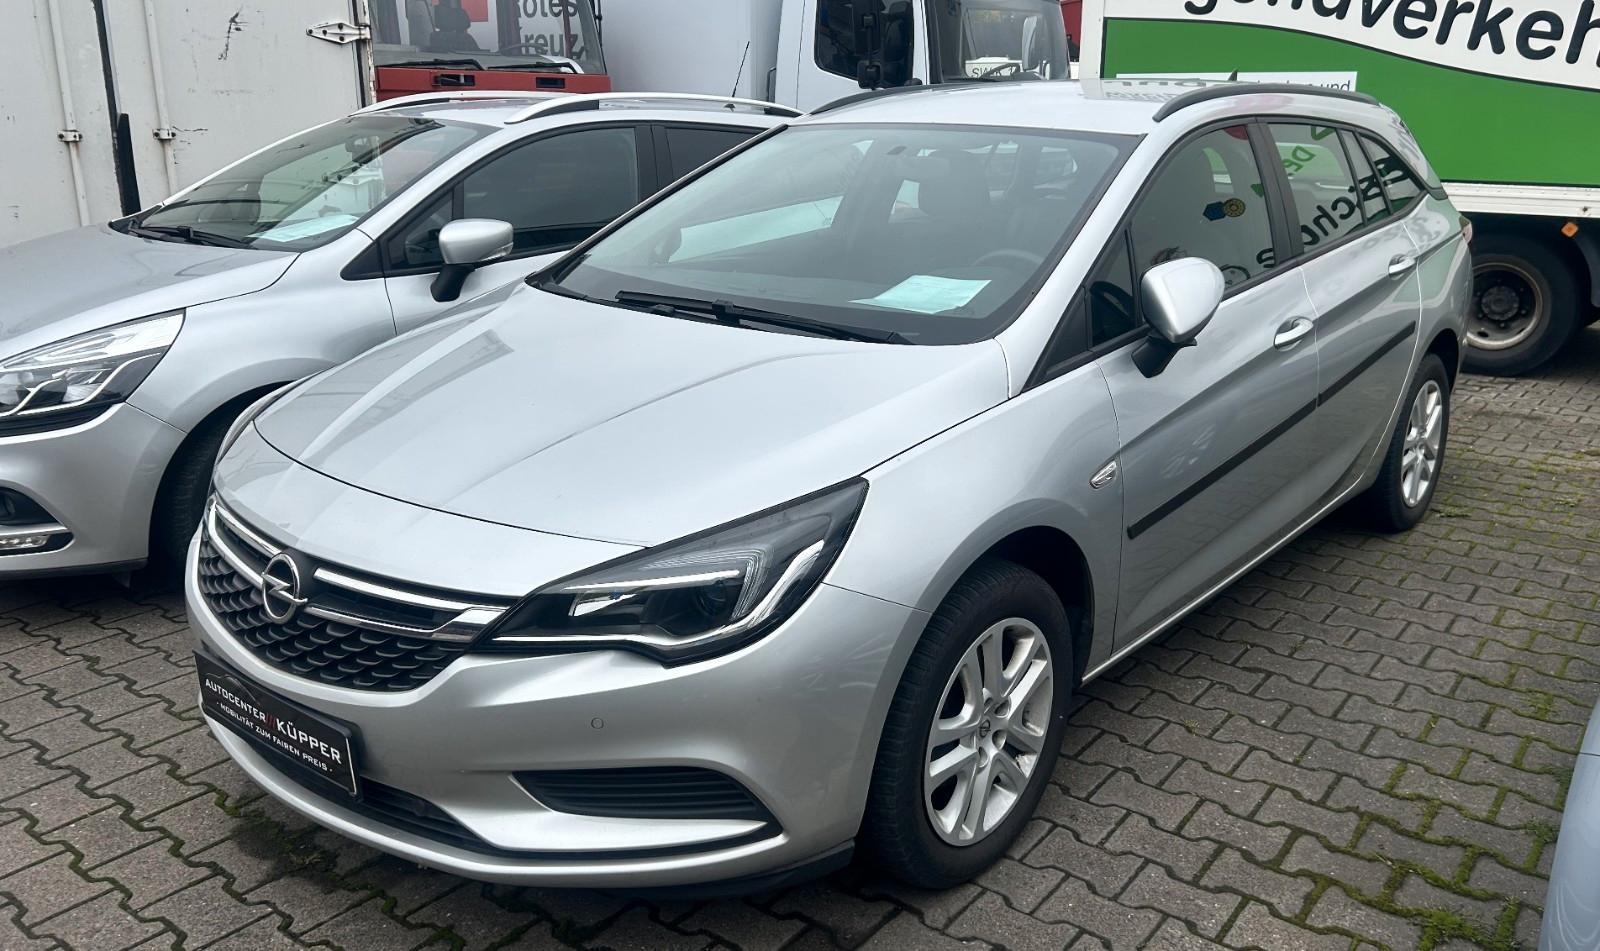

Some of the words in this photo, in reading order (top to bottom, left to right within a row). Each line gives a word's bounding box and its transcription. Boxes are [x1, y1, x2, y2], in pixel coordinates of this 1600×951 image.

[518, 0, 579, 18] otes
[519, 33, 581, 59] reuz
[205, 678, 266, 723] AUTOCENTER
[276, 718, 342, 764] KÜPPER
[220, 704, 254, 729] MOBILITÄT
[255, 726, 271, 740] ZUM
[272, 736, 300, 756] FAIREN
[302, 754, 328, 771] PREIS
